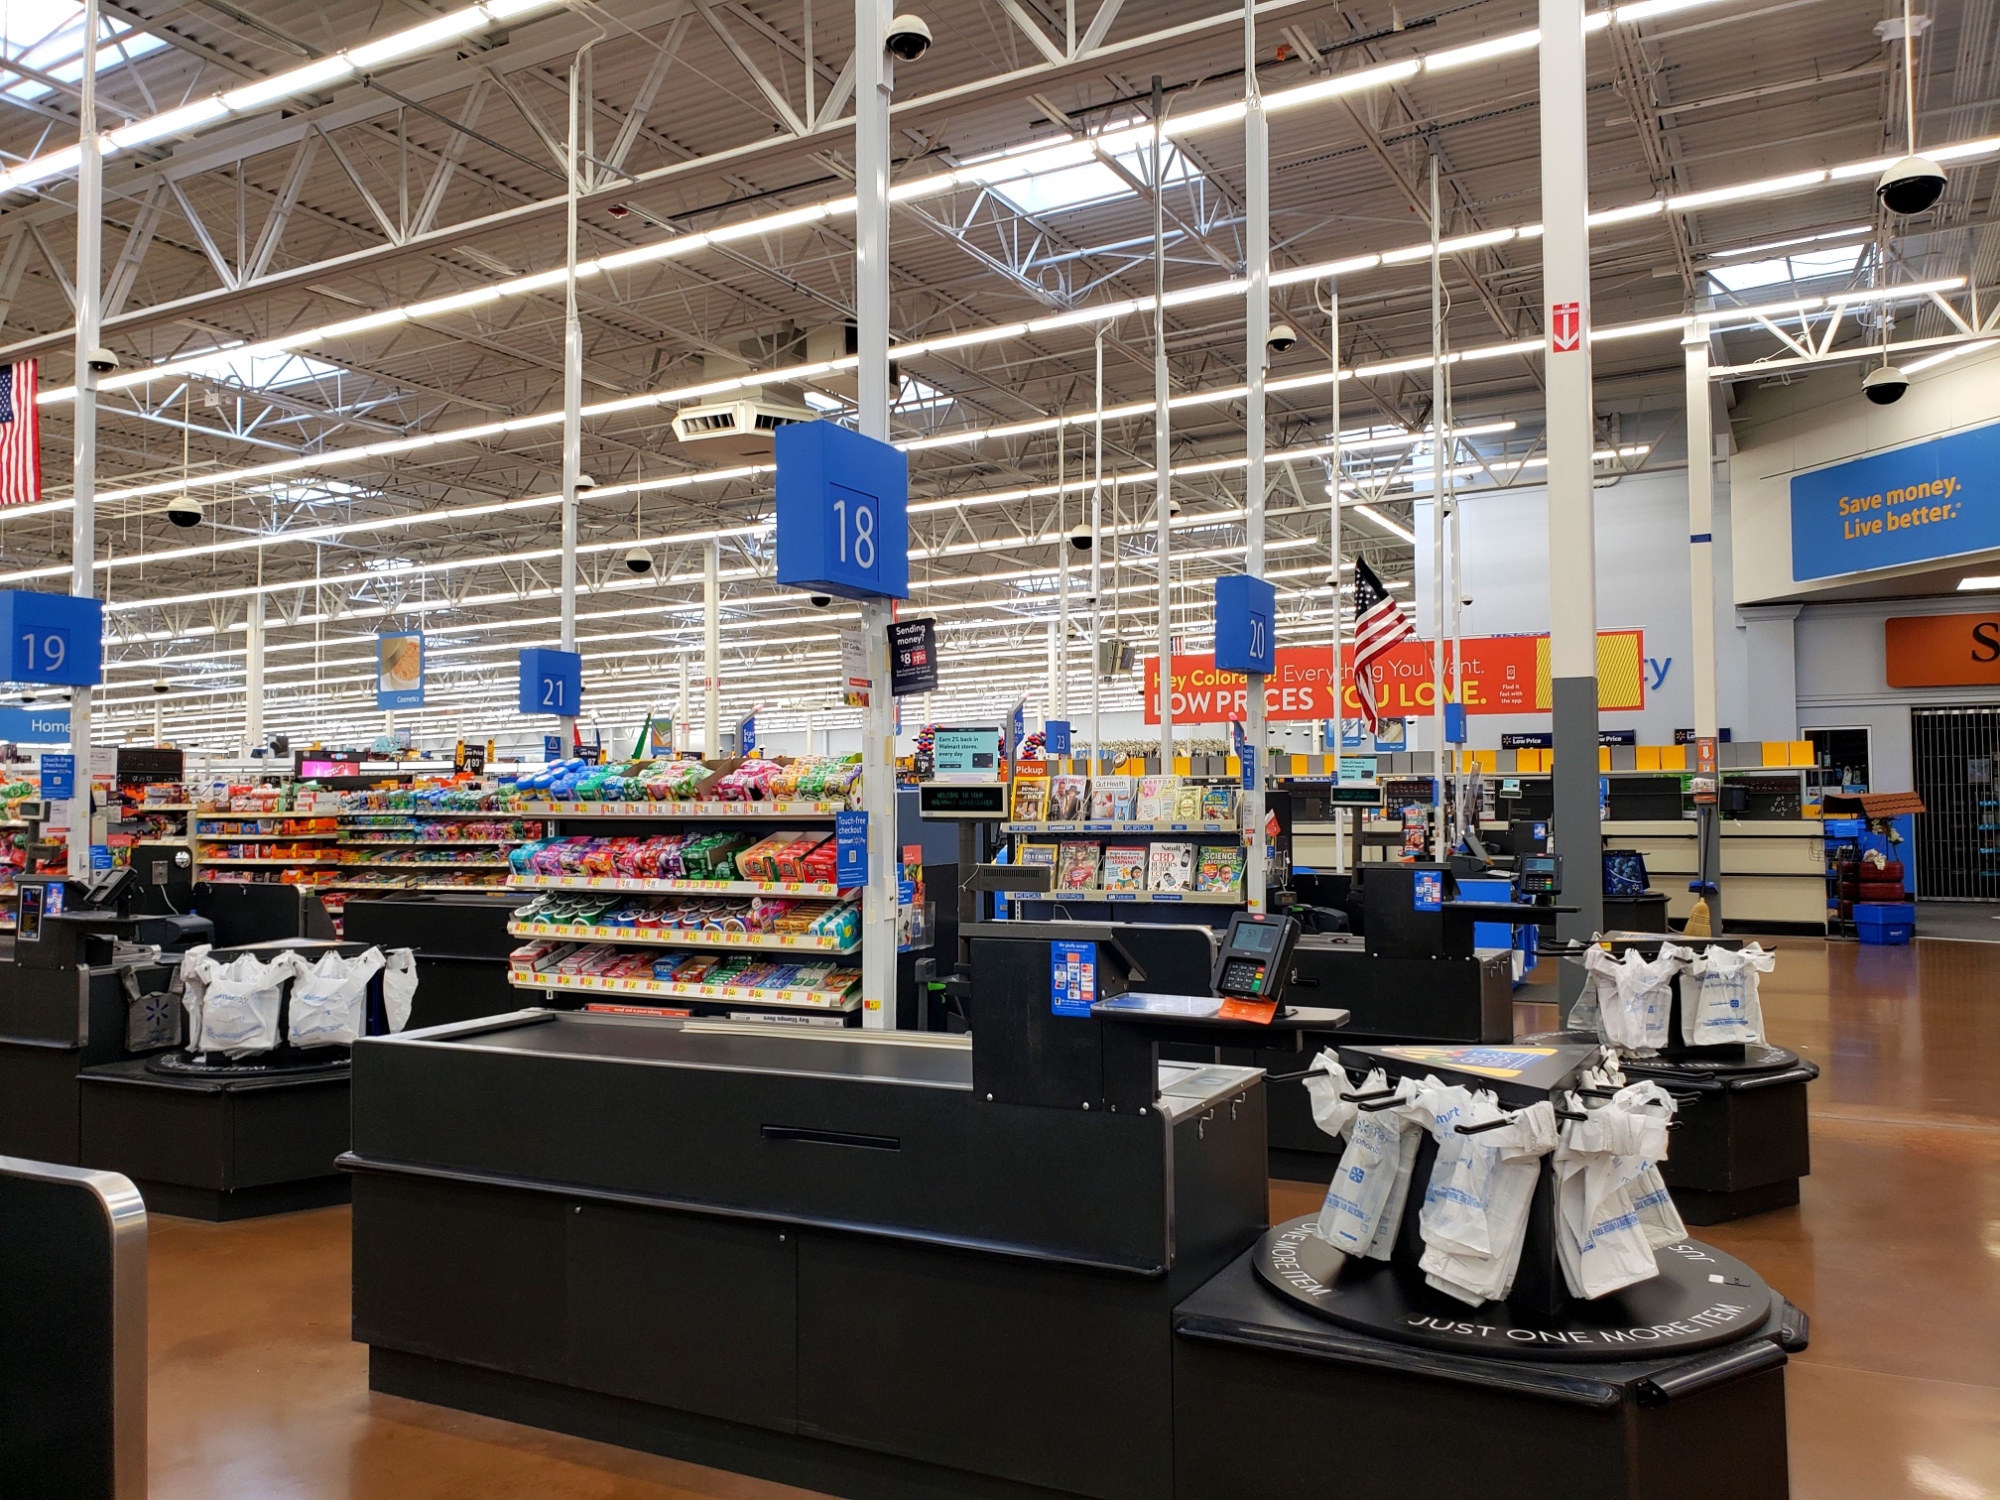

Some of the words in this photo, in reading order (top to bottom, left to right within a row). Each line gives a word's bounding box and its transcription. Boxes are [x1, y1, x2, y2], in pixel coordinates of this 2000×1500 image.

[1838, 492, 1883, 517] Save
[1886, 475, 1962, 507] money.
[1844, 516, 1883, 540] Live
[1886, 502, 1957, 532] better.
[833, 500, 875, 569] 18
[896, 624, 926, 636] Sending
[897, 633, 925, 646] money?
[1249, 619, 1265, 659] 20
[22, 633, 66, 672] 19
[1191, 665, 1277, 686] Colorao!
[1388, 659, 1423, 678] You
[543, 678, 565, 706] 21
[1154, 691, 1211, 716] LOW
[1216, 686, 1313, 713] PRCES
[1400, 680, 1487, 707] LOVE.
[31, 719, 71, 733] Home
[1057, 735, 1065, 750] 23
[1016, 766, 1043, 775] Pickup
[1107, 780, 1126, 788] Health
[838, 816, 866, 825] Touch-free
[838, 825, 862, 834] checkout
[1152, 853, 1175, 862] CBD
[1373, 1127, 1390, 1146] Pay
[1281, 1223, 1318, 1241] ONE
[1271, 1240, 1300, 1269] MORE
[1667, 1241, 1716, 1264] JUS
[1408, 1316, 1496, 1337] JUST
[1506, 1329, 1594, 1343] ONE
[1599, 1321, 1693, 1343] MORE
